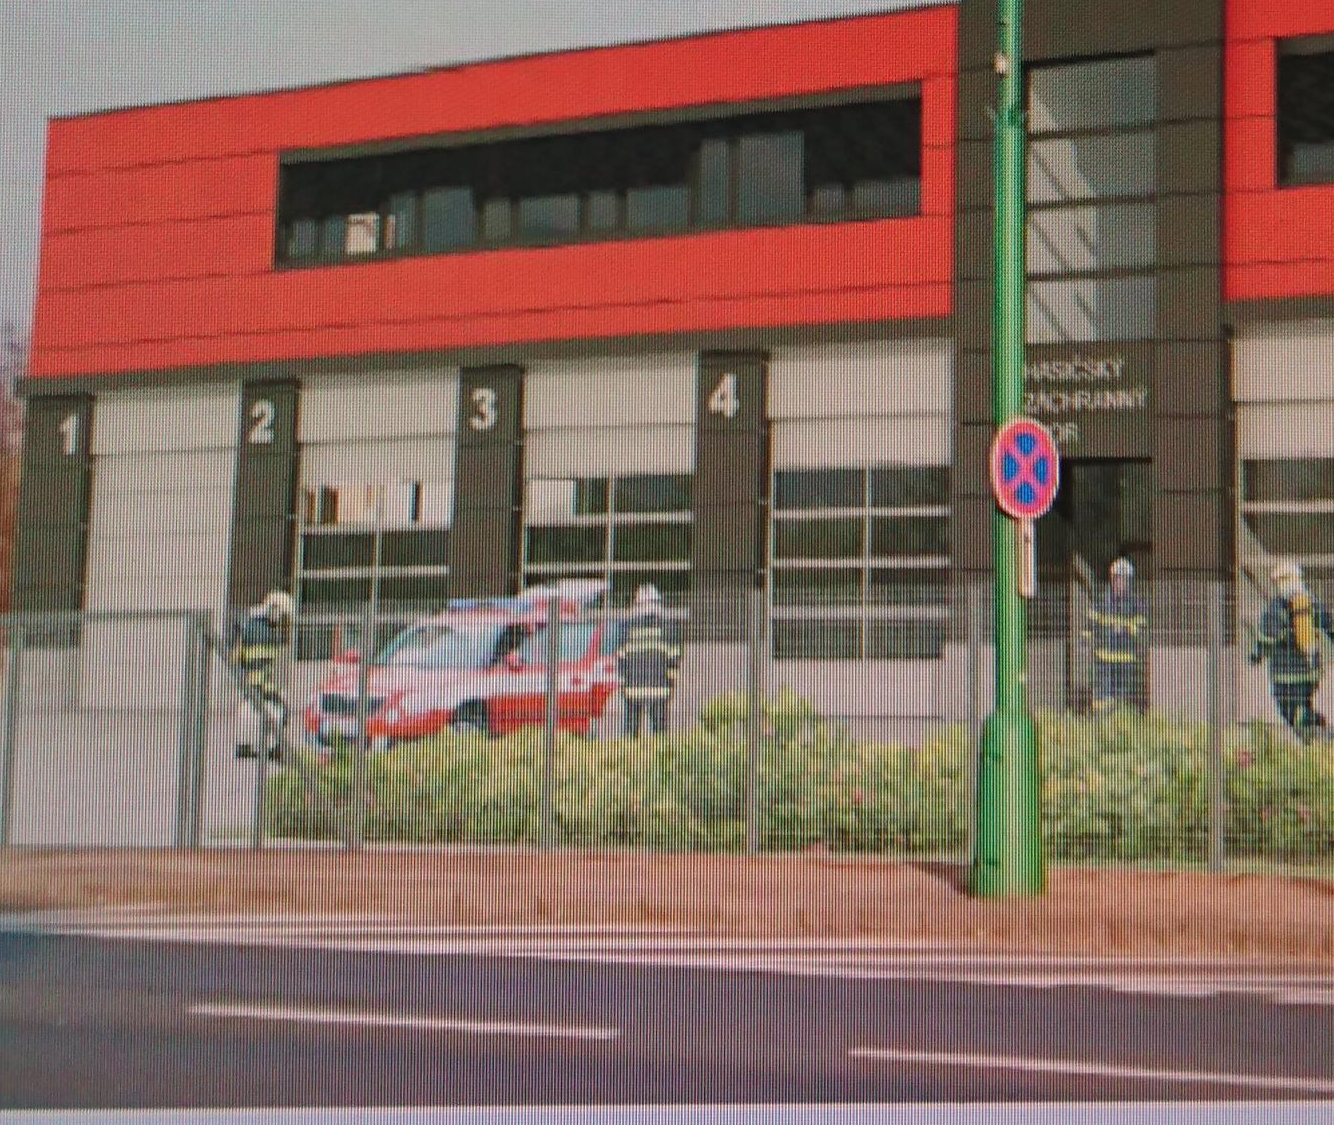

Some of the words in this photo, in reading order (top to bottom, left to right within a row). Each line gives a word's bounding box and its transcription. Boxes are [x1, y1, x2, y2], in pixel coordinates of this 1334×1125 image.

[469, 388, 497, 431] 3
[708, 372, 740, 418] 4
[58, 412, 80, 456] 1
[249, 399, 276, 444] 2
